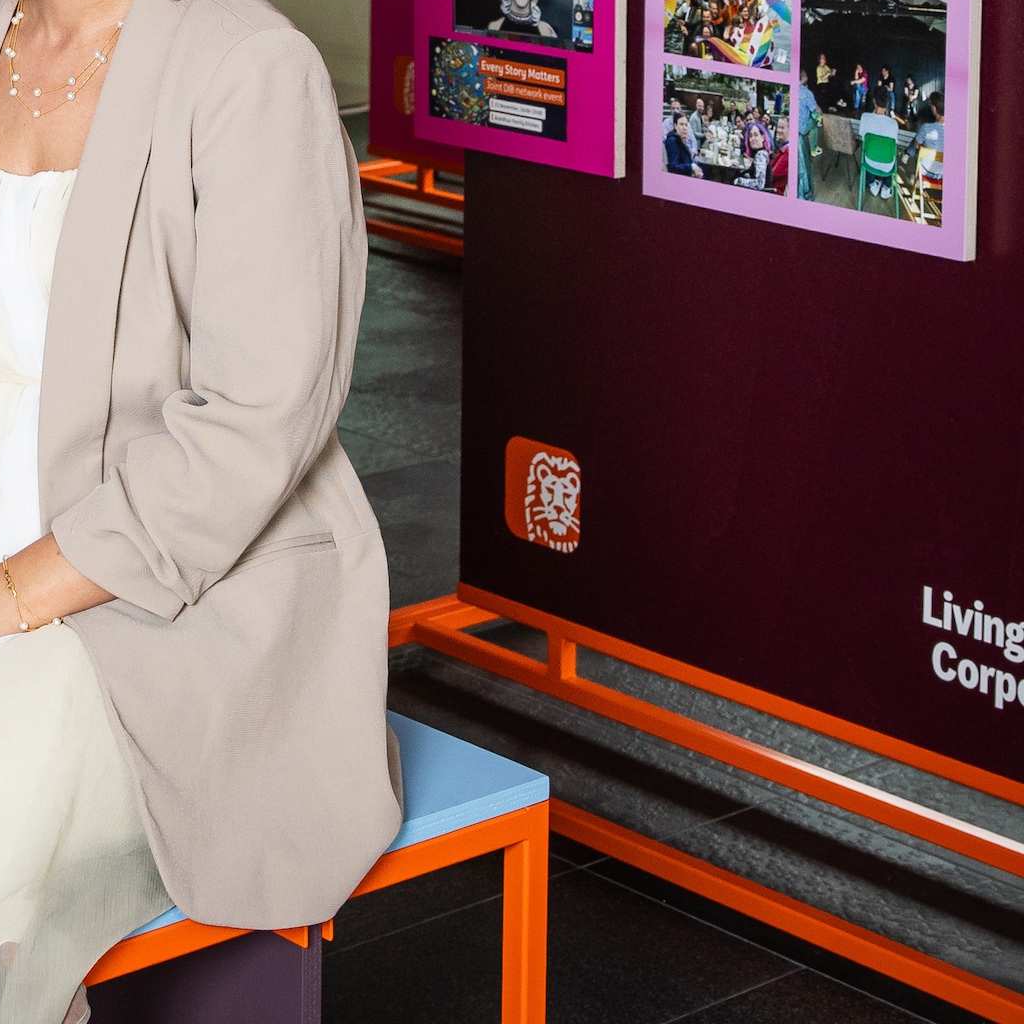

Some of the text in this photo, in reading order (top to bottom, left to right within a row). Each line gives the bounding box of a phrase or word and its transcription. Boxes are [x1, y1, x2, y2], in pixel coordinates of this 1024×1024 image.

[481, 60, 560, 83] Every Story Matters
[487, 81, 502, 92] Joint
[515, 87, 542, 98] network
[543, 93, 562, 102] event
[922, 585, 1024, 664] Living
